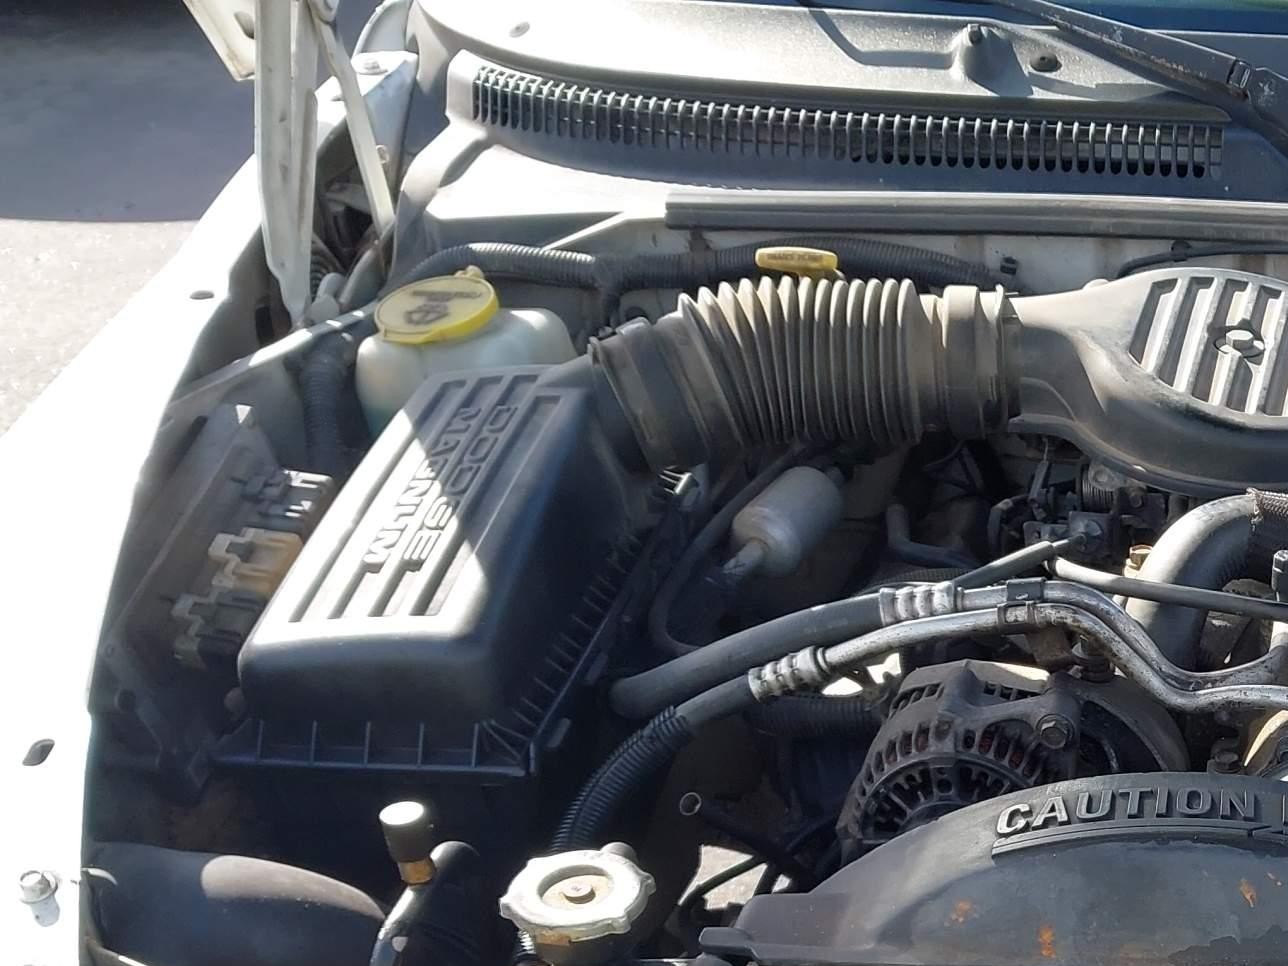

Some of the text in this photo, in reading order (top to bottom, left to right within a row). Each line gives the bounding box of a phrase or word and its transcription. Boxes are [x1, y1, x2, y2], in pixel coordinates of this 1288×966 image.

[362, 407, 482, 564] MAGNUM
[402, 402, 518, 563] DODGE
[996, 787, 1256, 835] CAUTION
